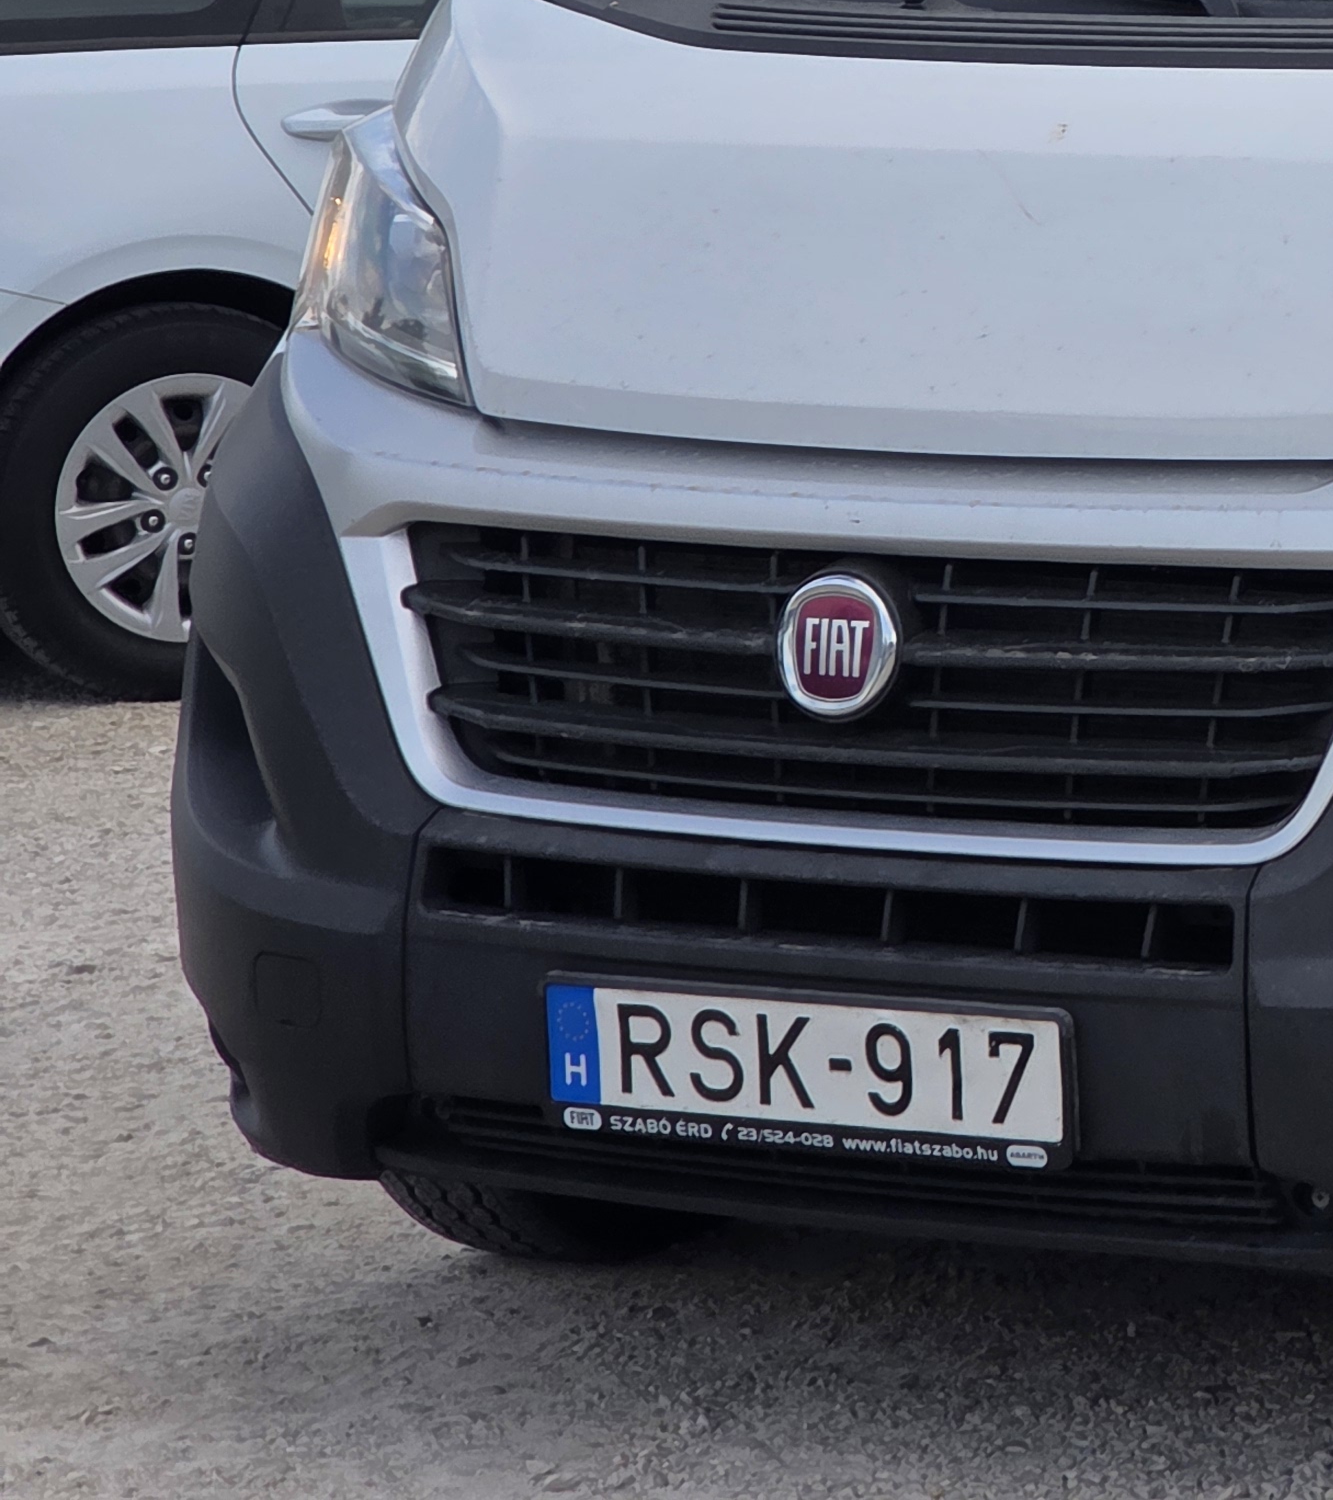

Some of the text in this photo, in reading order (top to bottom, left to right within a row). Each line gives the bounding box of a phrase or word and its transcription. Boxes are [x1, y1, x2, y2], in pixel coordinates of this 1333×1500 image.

[803, 617, 870, 678] FIAT
[565, 1052, 587, 1088] H
[616, 1002, 1035, 1125] RSK-917
[569, 1110, 595, 1126] FIAT
[609, 1115, 999, 1162] SZABÓ ÉRD 23/524-028 www.fiatszabo.hu
